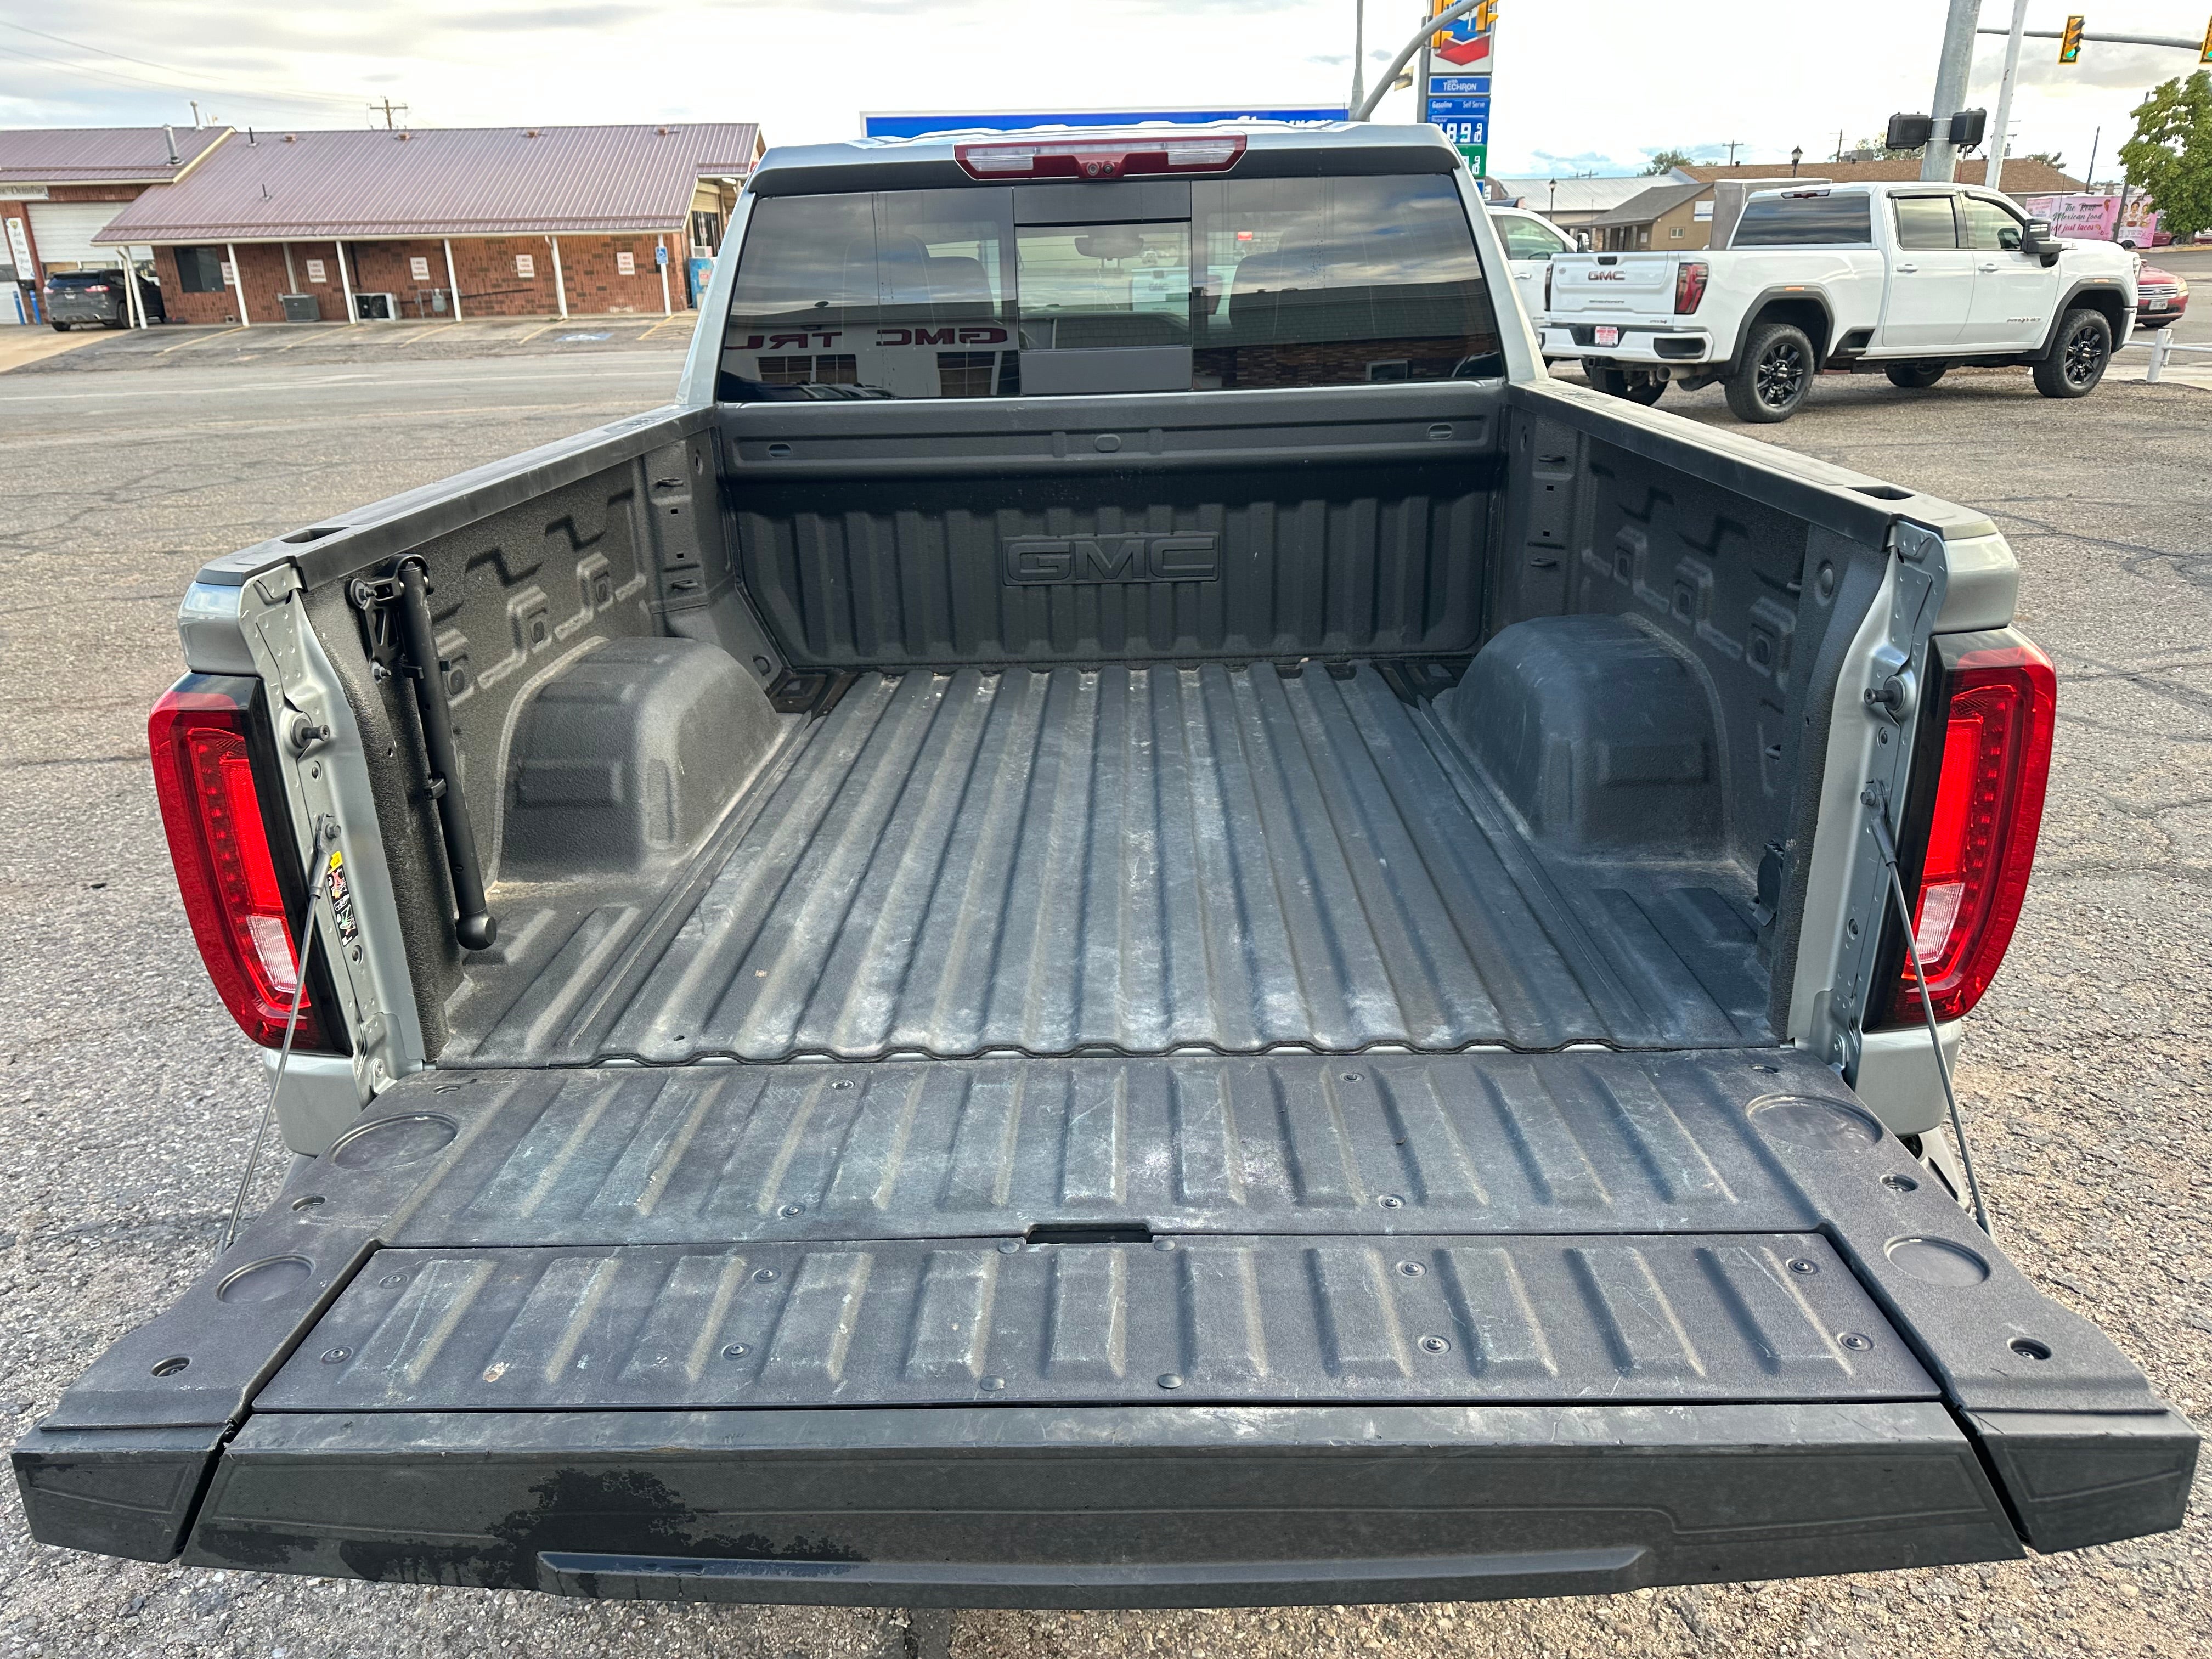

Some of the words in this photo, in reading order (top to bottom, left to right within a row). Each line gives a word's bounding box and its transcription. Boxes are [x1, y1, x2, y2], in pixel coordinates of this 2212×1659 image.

[1443, 82, 1477, 92] TECHRON
[1440, 123, 1471, 143] 89
[2064, 203, 2076, 212] The
[2052, 212, 2085, 221] Mexican
[2086, 212, 2103, 222] food
[2061, 224, 2076, 234] just
[1588, 271, 1626, 280] GMC
[1007, 537, 1215, 582] GMC
